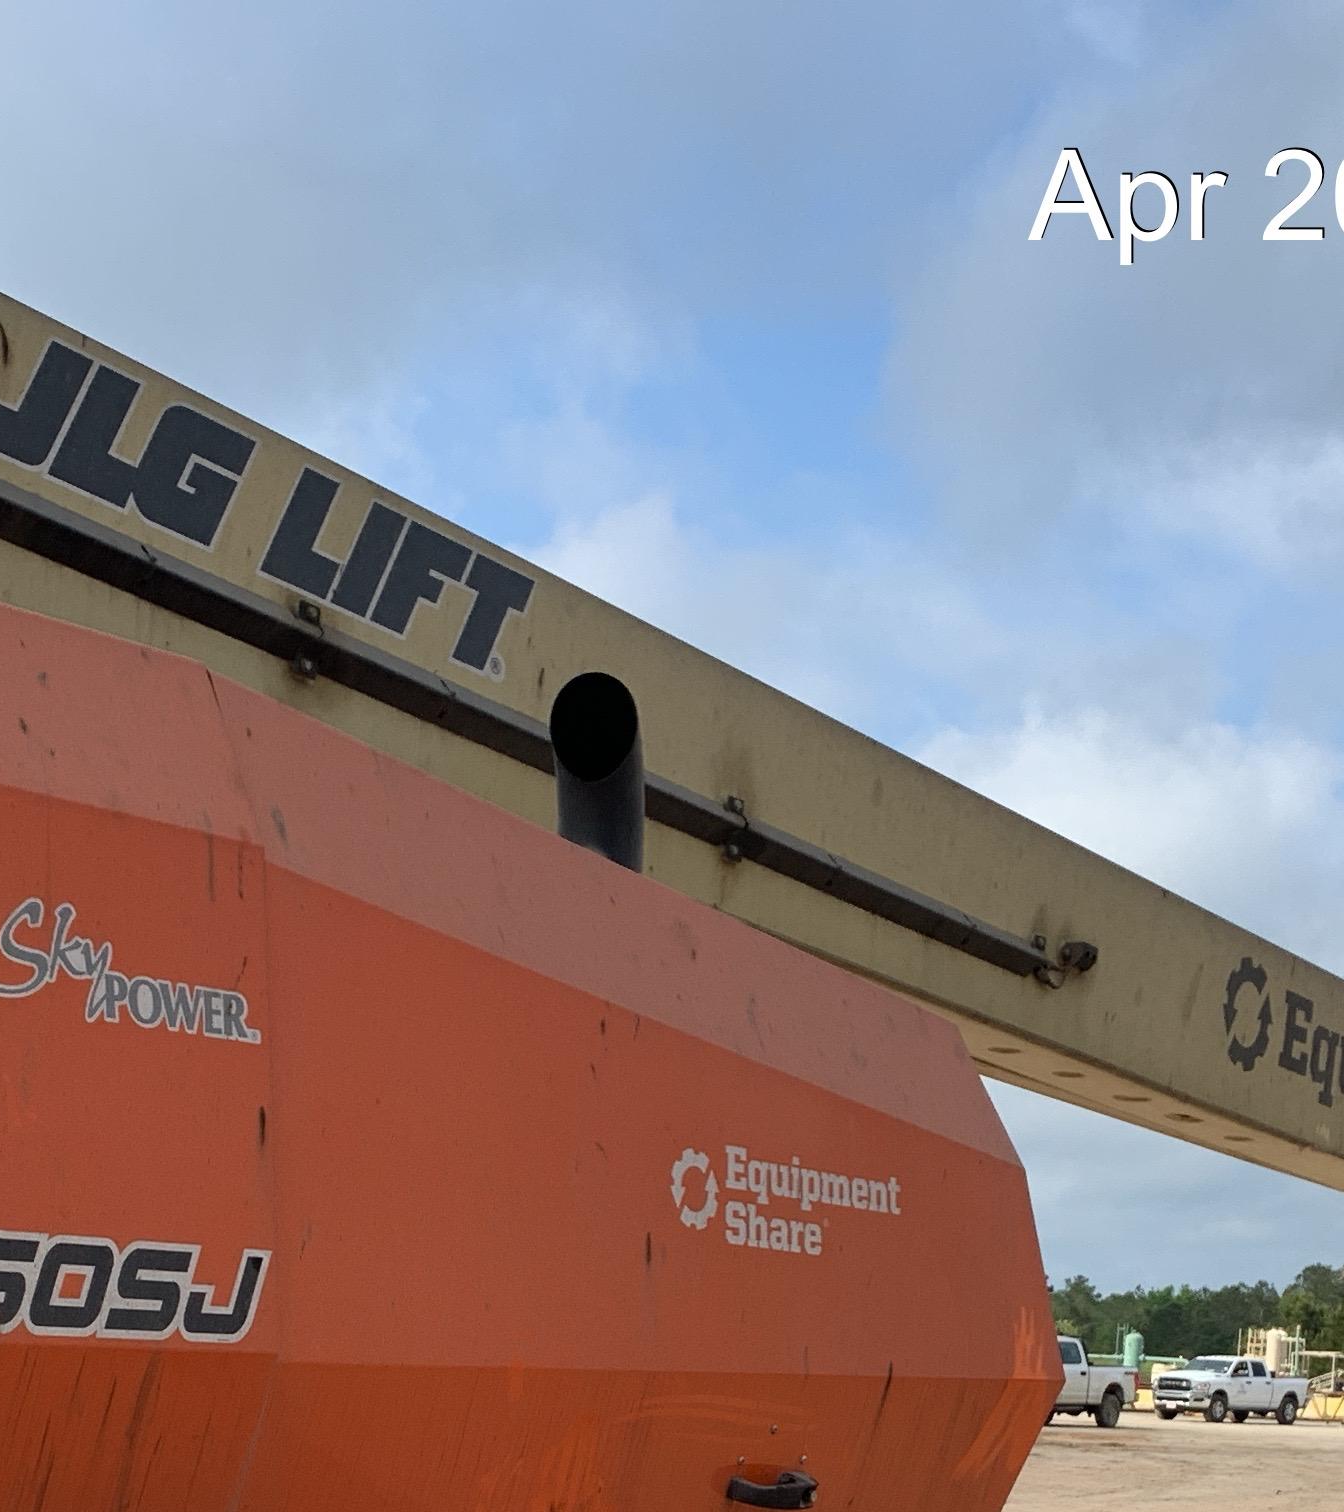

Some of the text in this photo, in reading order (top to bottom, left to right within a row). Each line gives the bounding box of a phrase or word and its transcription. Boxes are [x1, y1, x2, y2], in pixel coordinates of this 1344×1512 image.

[258, 464, 536, 672] LIFT
[725, 1144, 902, 1216] Equipment
[724, 1200, 823, 1257] Share
